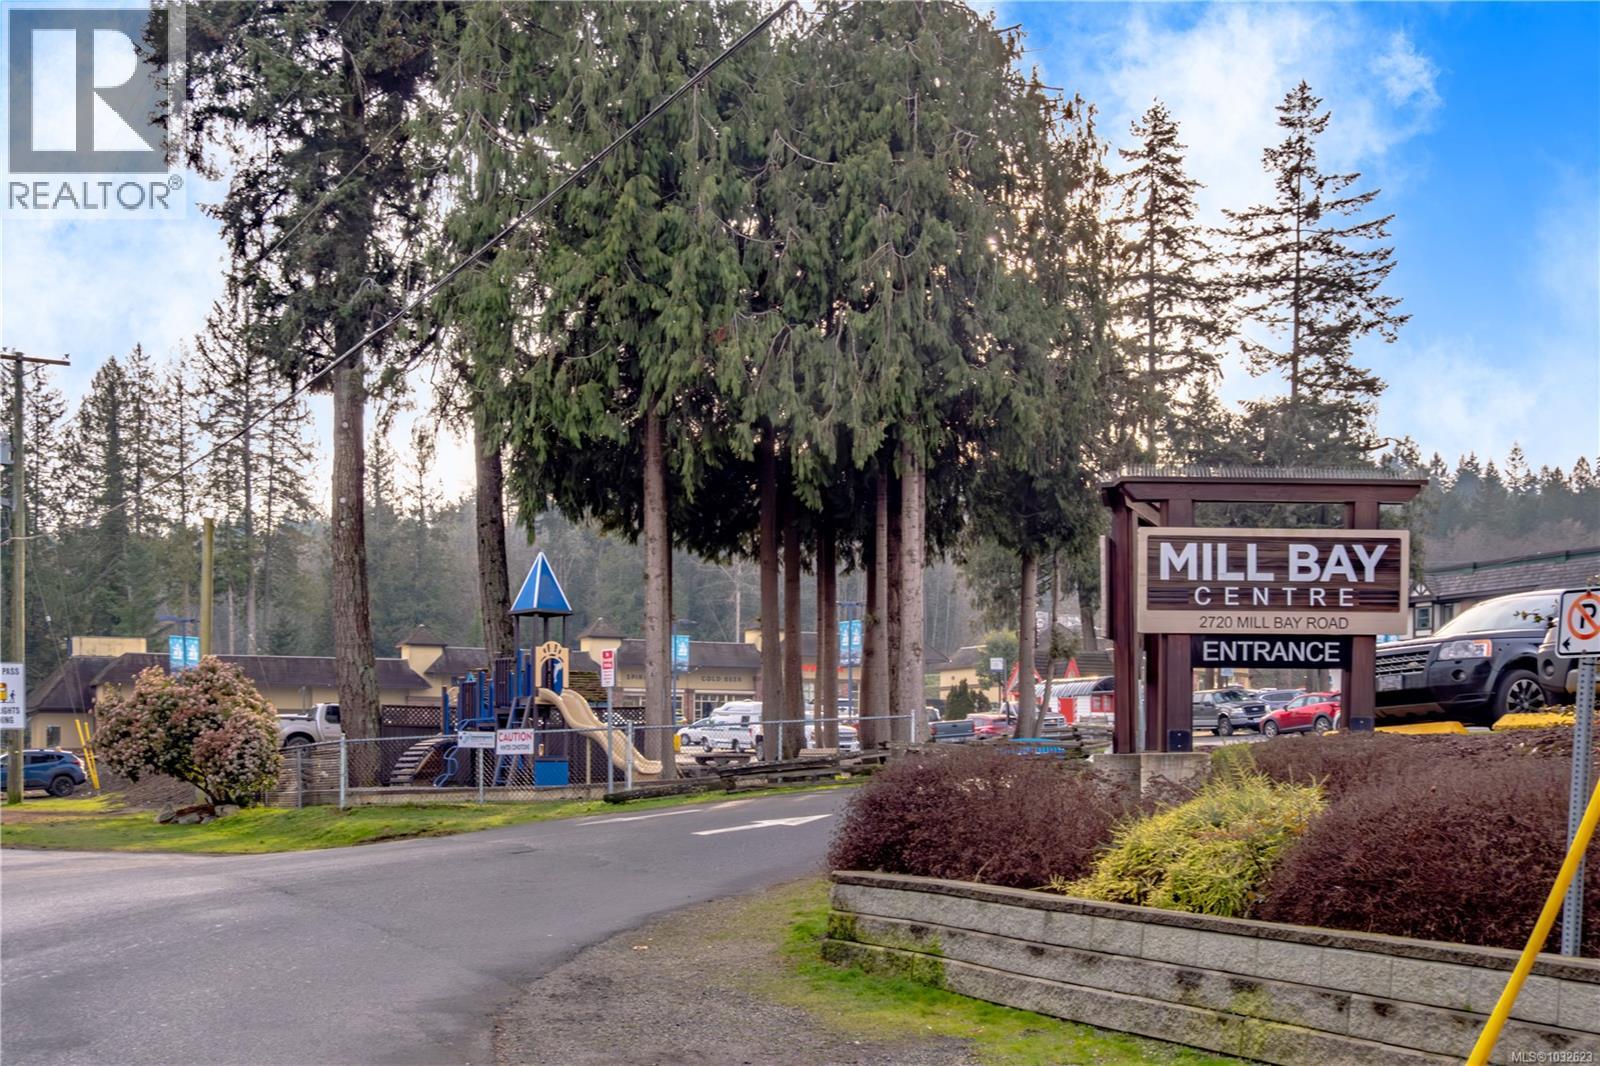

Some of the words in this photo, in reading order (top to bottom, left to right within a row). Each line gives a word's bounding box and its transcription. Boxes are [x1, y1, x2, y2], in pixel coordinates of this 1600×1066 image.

[1159, 542, 1275, 582] MILL
[1288, 543, 1388, 583] BAY
[1193, 585, 1355, 607] CENTRE
[1199, 615, 1233, 629] 2720
[1236, 616, 1269, 630] MILL
[1274, 616, 1304, 630] BAY
[1306, 616, 1349, 630] ROAD
[1202, 640, 1340, 662] ENTRANCE
[1, 667, 20, 675] PASS
[0, 706, 20, 715] IGHTS
[498, 731, 533, 743] CAUTION
